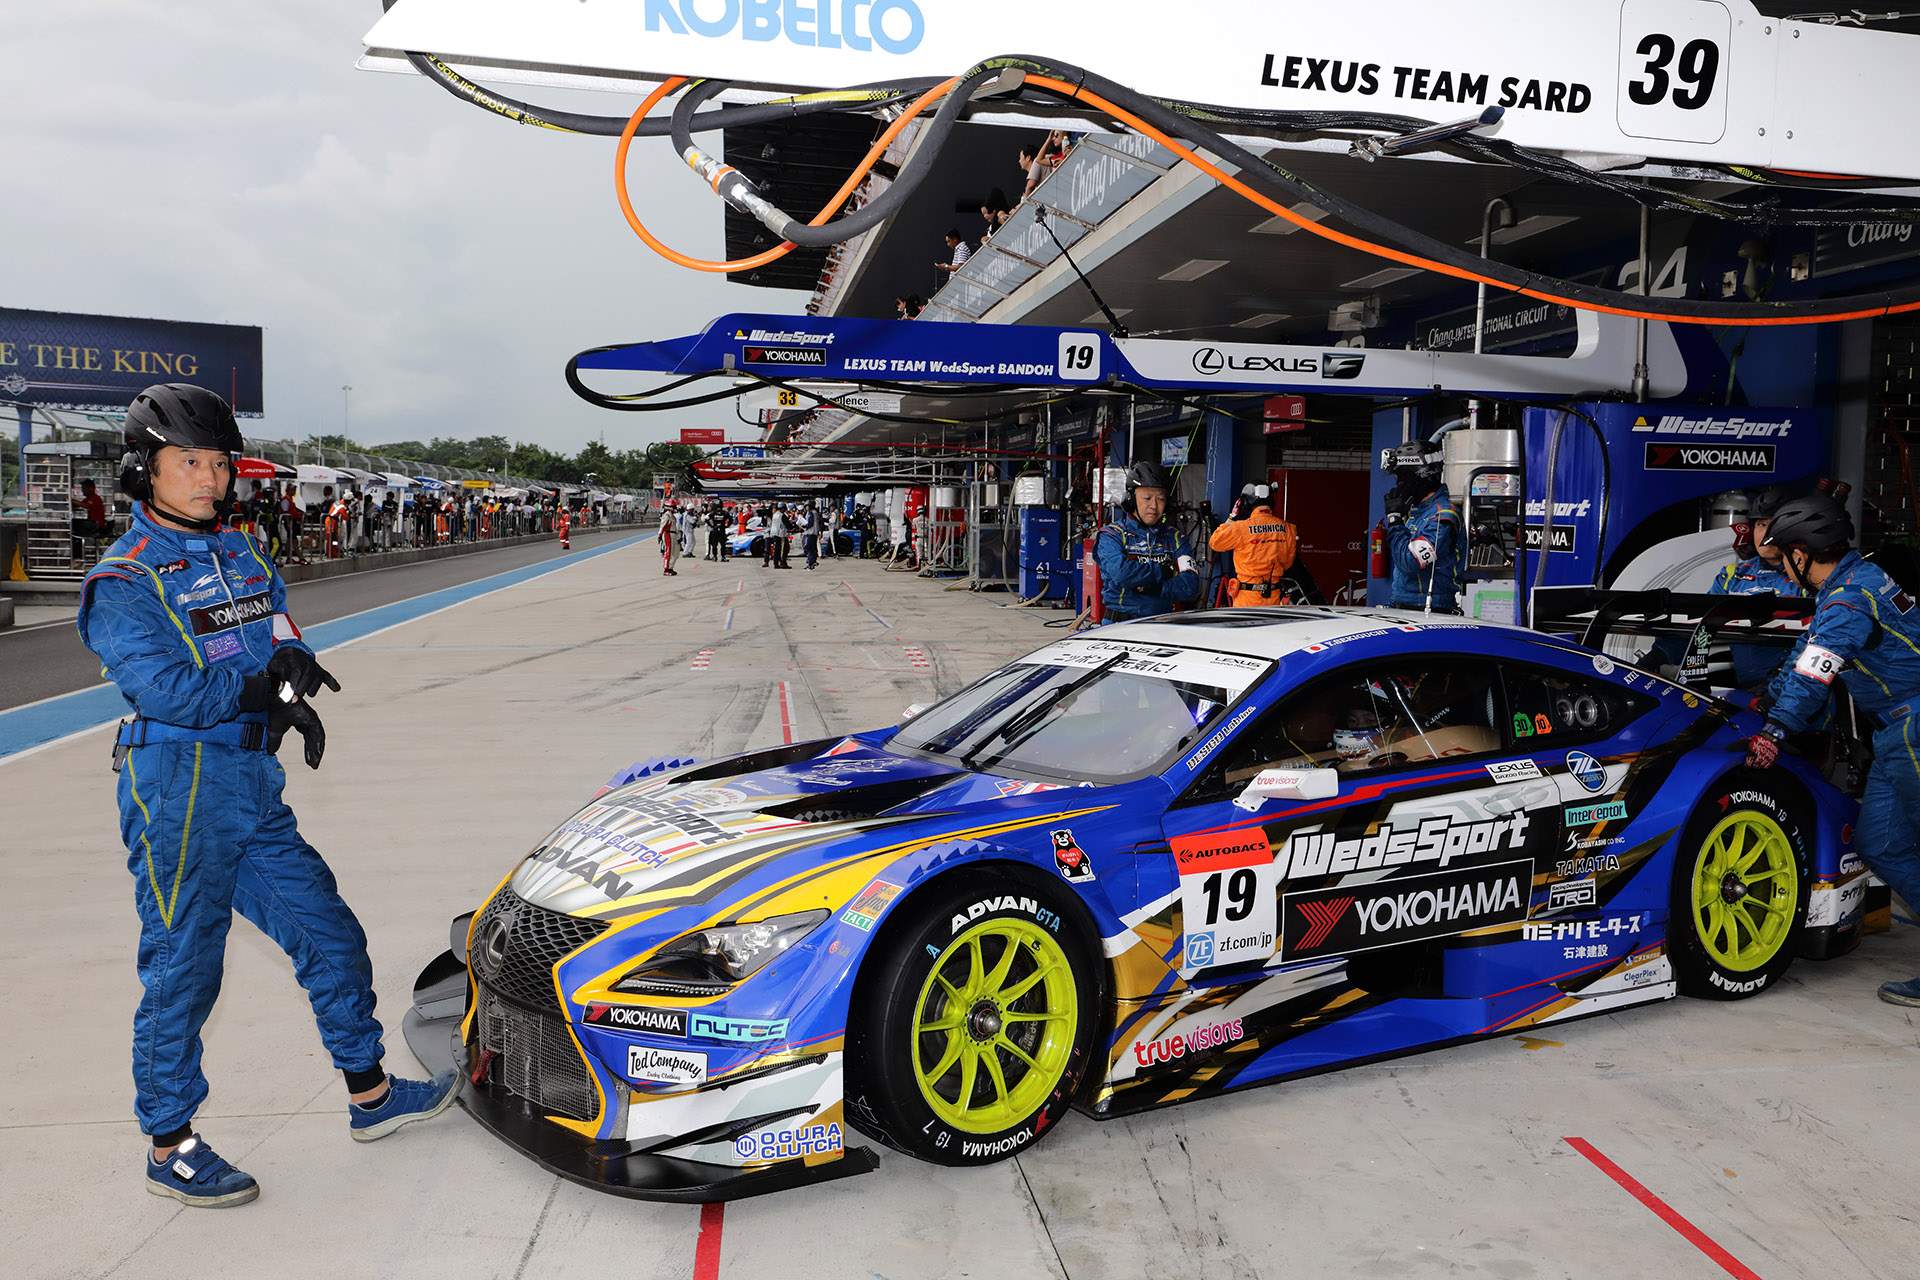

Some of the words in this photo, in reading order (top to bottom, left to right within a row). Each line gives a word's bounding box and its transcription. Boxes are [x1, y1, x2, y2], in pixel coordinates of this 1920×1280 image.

[644, 0, 925, 54] KOBELCO
[1628, 33, 1719, 111] 39
[1260, 53, 1380, 96] LEXUS
[1394, 66, 1489, 105] TEAM
[1498, 77, 1592, 114] SARD
[1515, 304, 1550, 328] CIRCUIT
[748, 329, 835, 345] WedsSport
[28, 344, 103, 372] THE
[112, 349, 199, 376] KING
[764, 350, 822, 363] YOKOHAMA
[844, 358, 887, 371] LEXUS
[890, 359, 927, 373] TEAM
[930, 361, 995, 376] WedsSport
[998, 363, 1055, 376] BANDOH
[1065, 345, 1095, 370] 19
[1228, 355, 1318, 373] LEXUS
[780, 391, 797, 406] 33
[1656, 415, 1792, 439] WedsSport
[1680, 449, 1767, 466] YOKOHAMA
[1248, 523, 1287, 535] TECHNICAL
[1036, 562, 1050, 574] 61
[1215, 656, 1261, 668] LEXUS
[1513, 718, 1528, 732] 30
[1536, 718, 1546, 730] 10
[1489, 761, 1535, 774] LEXUS
[1257, 775, 1275, 785] true
[1275, 777, 1299, 785] visions
[1729, 790, 1776, 810] YOKOHAMA
[1195, 841, 1266, 859] AUTOBACS
[1288, 810, 1531, 880] WedsSport
[527, 845, 633, 901] ADVAN
[1556, 854, 1620, 877] TAKATA
[1202, 868, 1257, 926] 19
[1354, 877, 1521, 935] YOKOHAMA
[1552, 890, 1592, 905] TRD
[845, 912, 874, 930] TACTI
[951, 896, 1037, 935] ADVAN
[1036, 908, 1060, 932] GTA
[1521, 923, 1582, 941] カミナリ
[1586, 915, 1641, 937] モータース
[1190, 937, 1212, 962] ZF
[1220, 932, 1272, 953] zf.com/jp
[1563, 944, 1609, 960] 石津建設
[1623, 968, 1658, 982] ClearPlex
[1709, 971, 1767, 993] ADVAN
[610, 1007, 680, 1031] YOKOHAMA
[1133, 1034, 1185, 1068] true
[1185, 1018, 1243, 1054] visions
[631, 1051, 649, 1072] Ted
[649, 1051, 702, 1079] Company
[761, 1123, 842, 1144] OGURA
[962, 1128, 1033, 1156] YOKOHAMA
[761, 1138, 843, 1160] CLUTCH
